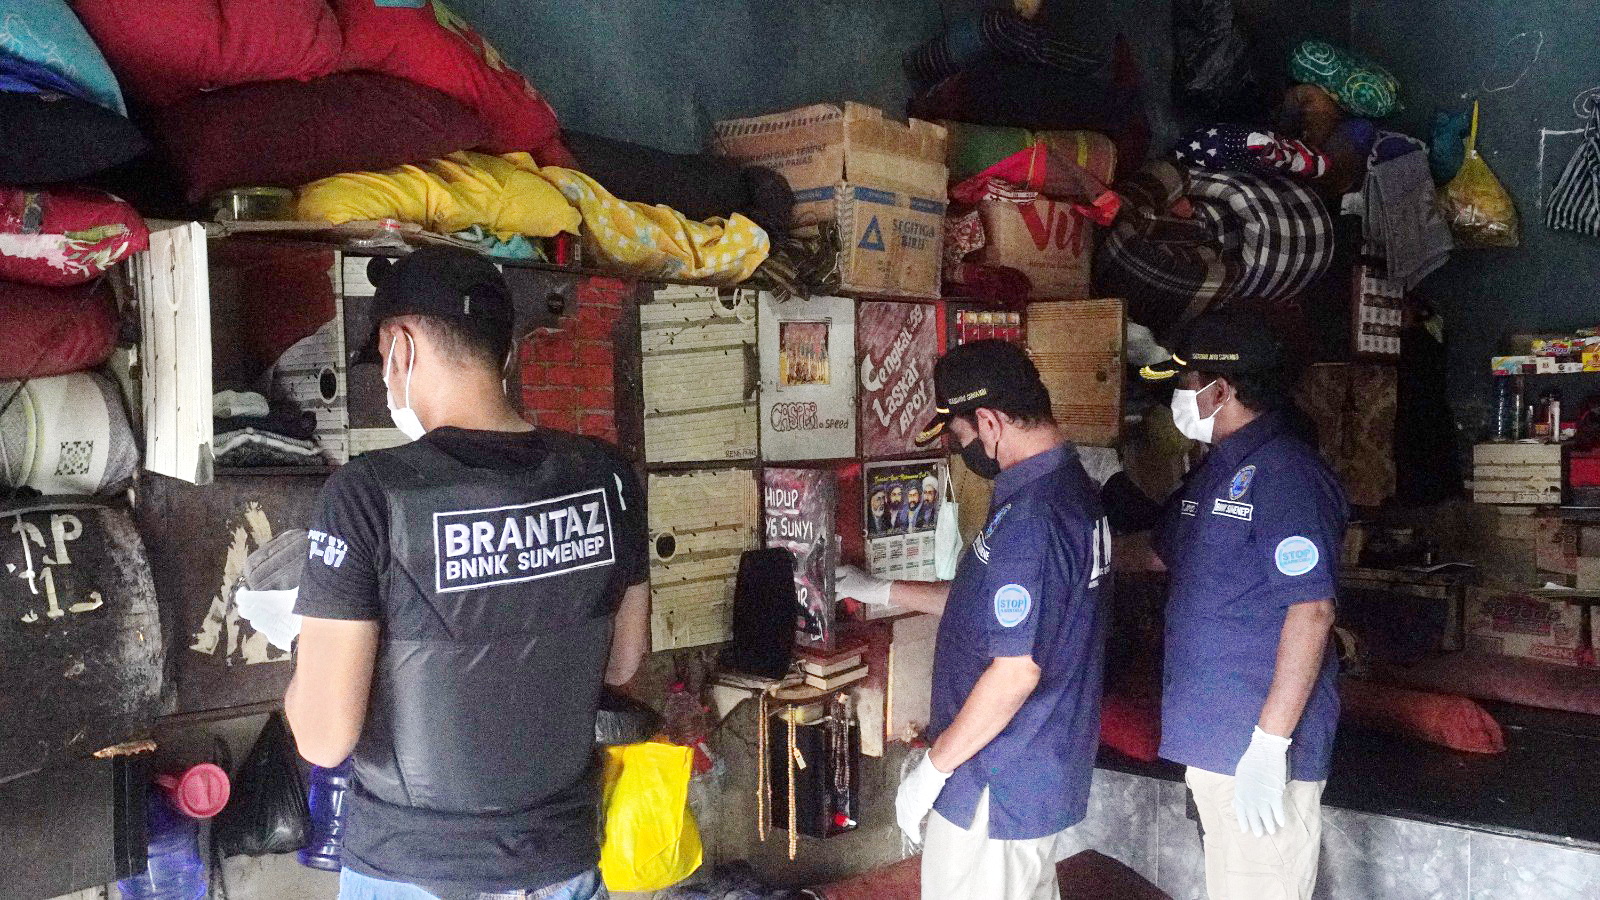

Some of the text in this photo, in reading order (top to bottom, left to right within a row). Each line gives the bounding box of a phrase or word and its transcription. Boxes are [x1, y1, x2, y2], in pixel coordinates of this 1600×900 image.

[765, 486, 798, 509] HIDUP
[445, 502, 604, 558] BRANTAZ
[781, 517, 813, 540] SUNYI
[446, 536, 604, 580] BNNK SUMENEP
[1282, 549, 1310, 561] STOP
[1000, 599, 1024, 609] STOP
